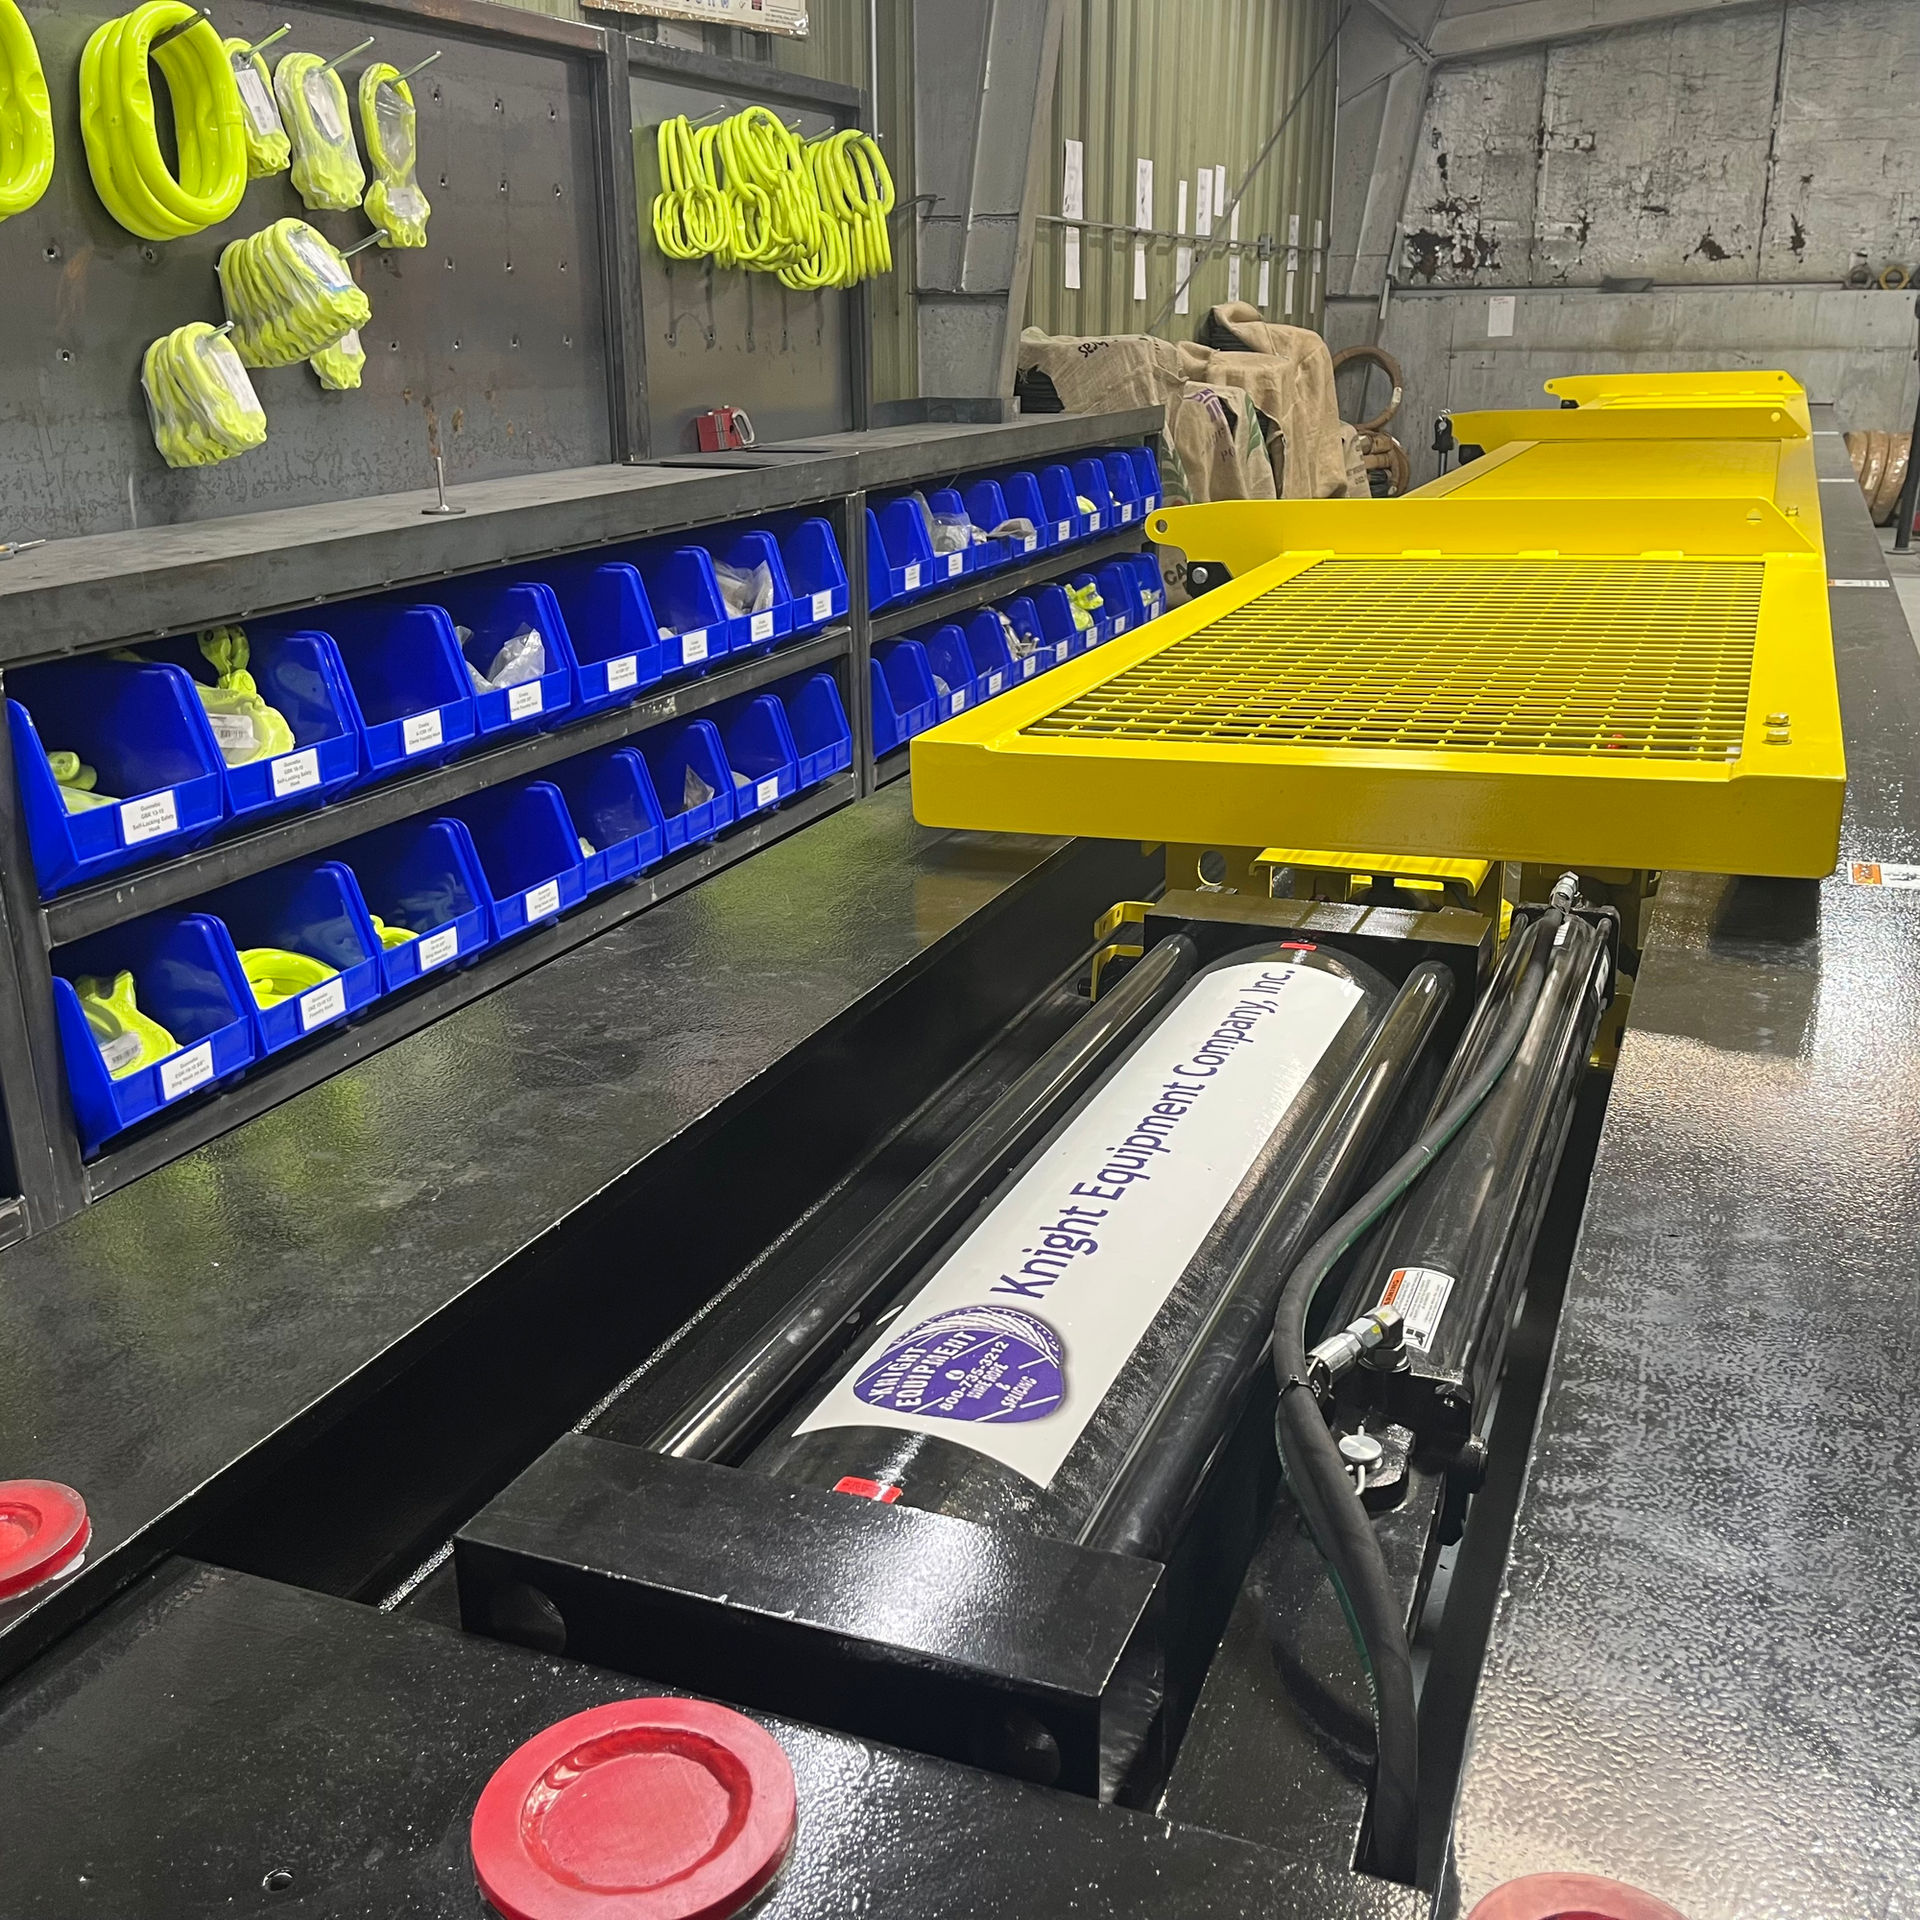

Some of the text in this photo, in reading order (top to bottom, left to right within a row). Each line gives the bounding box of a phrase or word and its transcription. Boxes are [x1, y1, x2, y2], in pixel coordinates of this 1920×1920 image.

[990, 969, 1296, 1299] Knight Equipment Company, Inc.
[867, 1345, 928, 1398] KNIGHT
[895, 1331, 977, 1407] EQUIPMENT
[938, 1340, 1010, 1412] 800-735-3212
